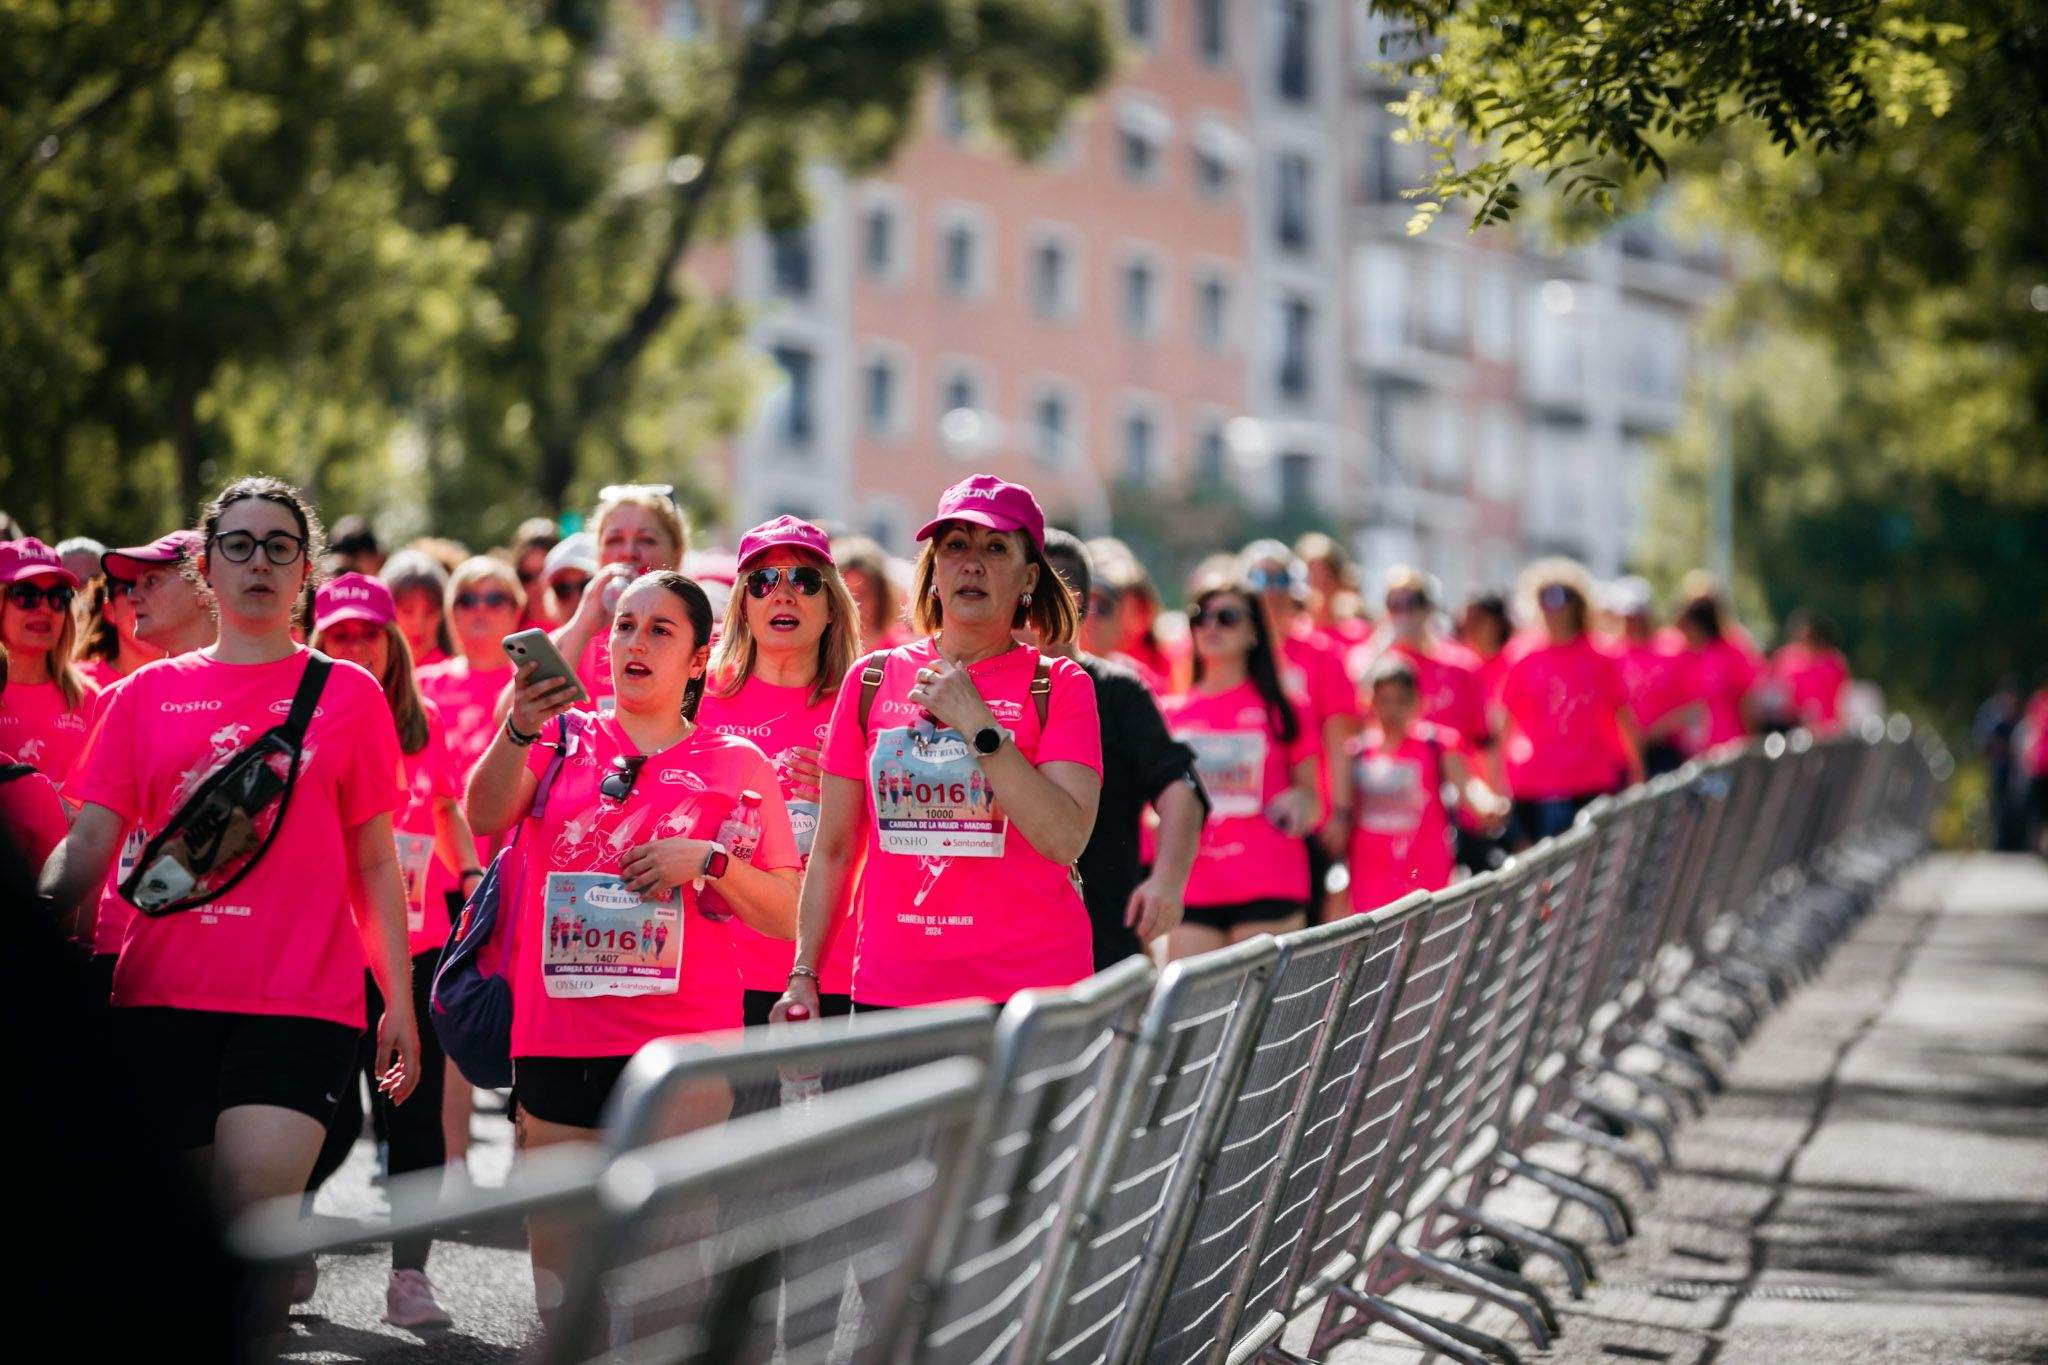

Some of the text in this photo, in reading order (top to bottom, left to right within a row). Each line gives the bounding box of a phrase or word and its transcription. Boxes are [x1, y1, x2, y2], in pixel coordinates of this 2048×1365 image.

[160, 700, 222, 713] OYSHO
[716, 724, 771, 737] OYSHO
[915, 783, 965, 803] 016
[926, 809, 954, 819] 10000
[888, 821, 919, 829] CARRERA
[920, 821, 928, 829] DE
[929, 821, 937, 829] LA
[938, 821, 959, 830] MUJER
[964, 822, 993, 830] MADRID
[889, 835, 994, 848] OYSHO Santander
[589, 890, 641, 905] ASTURIANA
[897, 913, 974, 926] CARRERA DE LA MUJER
[924, 926, 942, 936] 2024
[585, 928, 637, 950] 016
[595, 954, 619, 963] 1407
[555, 965, 583, 973] CARRERA
[633, 968, 662, 976] MADRID
